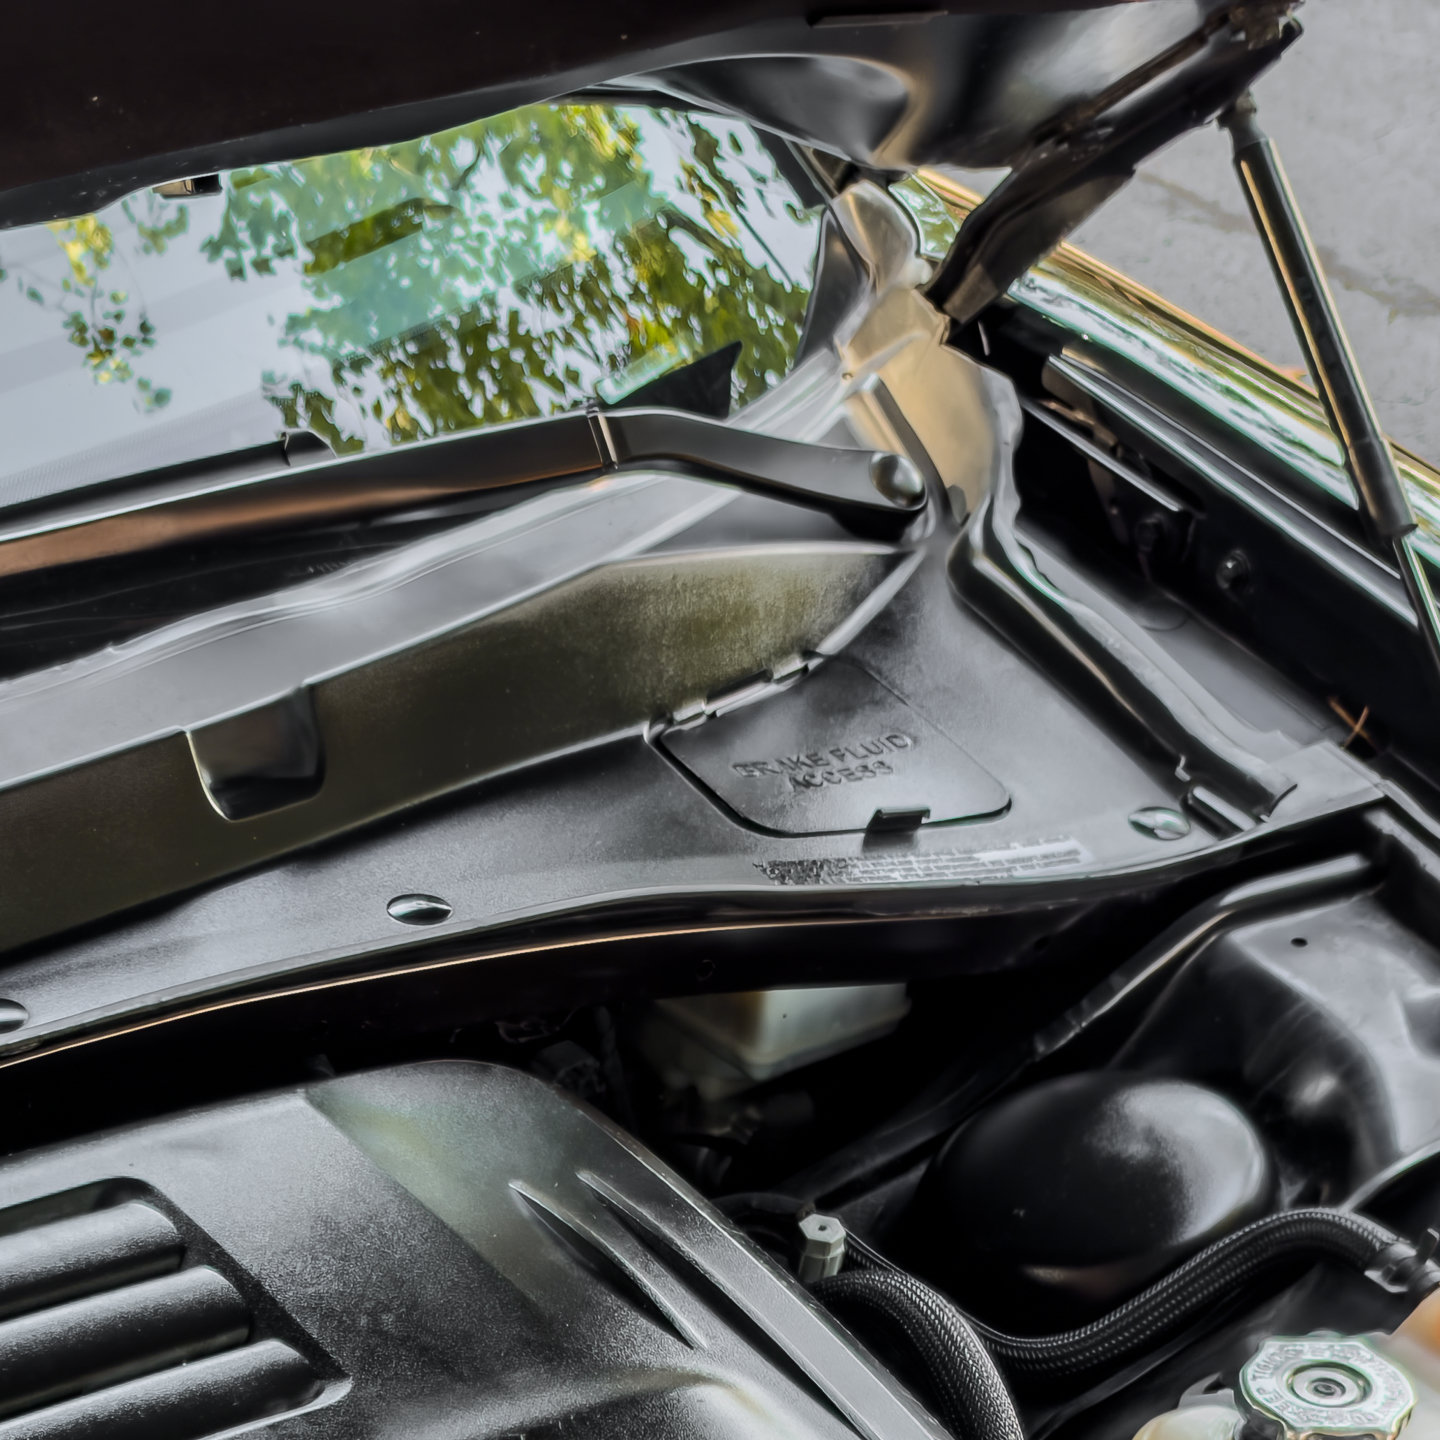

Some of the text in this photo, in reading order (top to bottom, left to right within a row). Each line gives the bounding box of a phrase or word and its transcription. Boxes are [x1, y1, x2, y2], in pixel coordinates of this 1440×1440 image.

[731, 733, 914, 779] BRAKE FLUID
[789, 761, 894, 792] ACCESS
